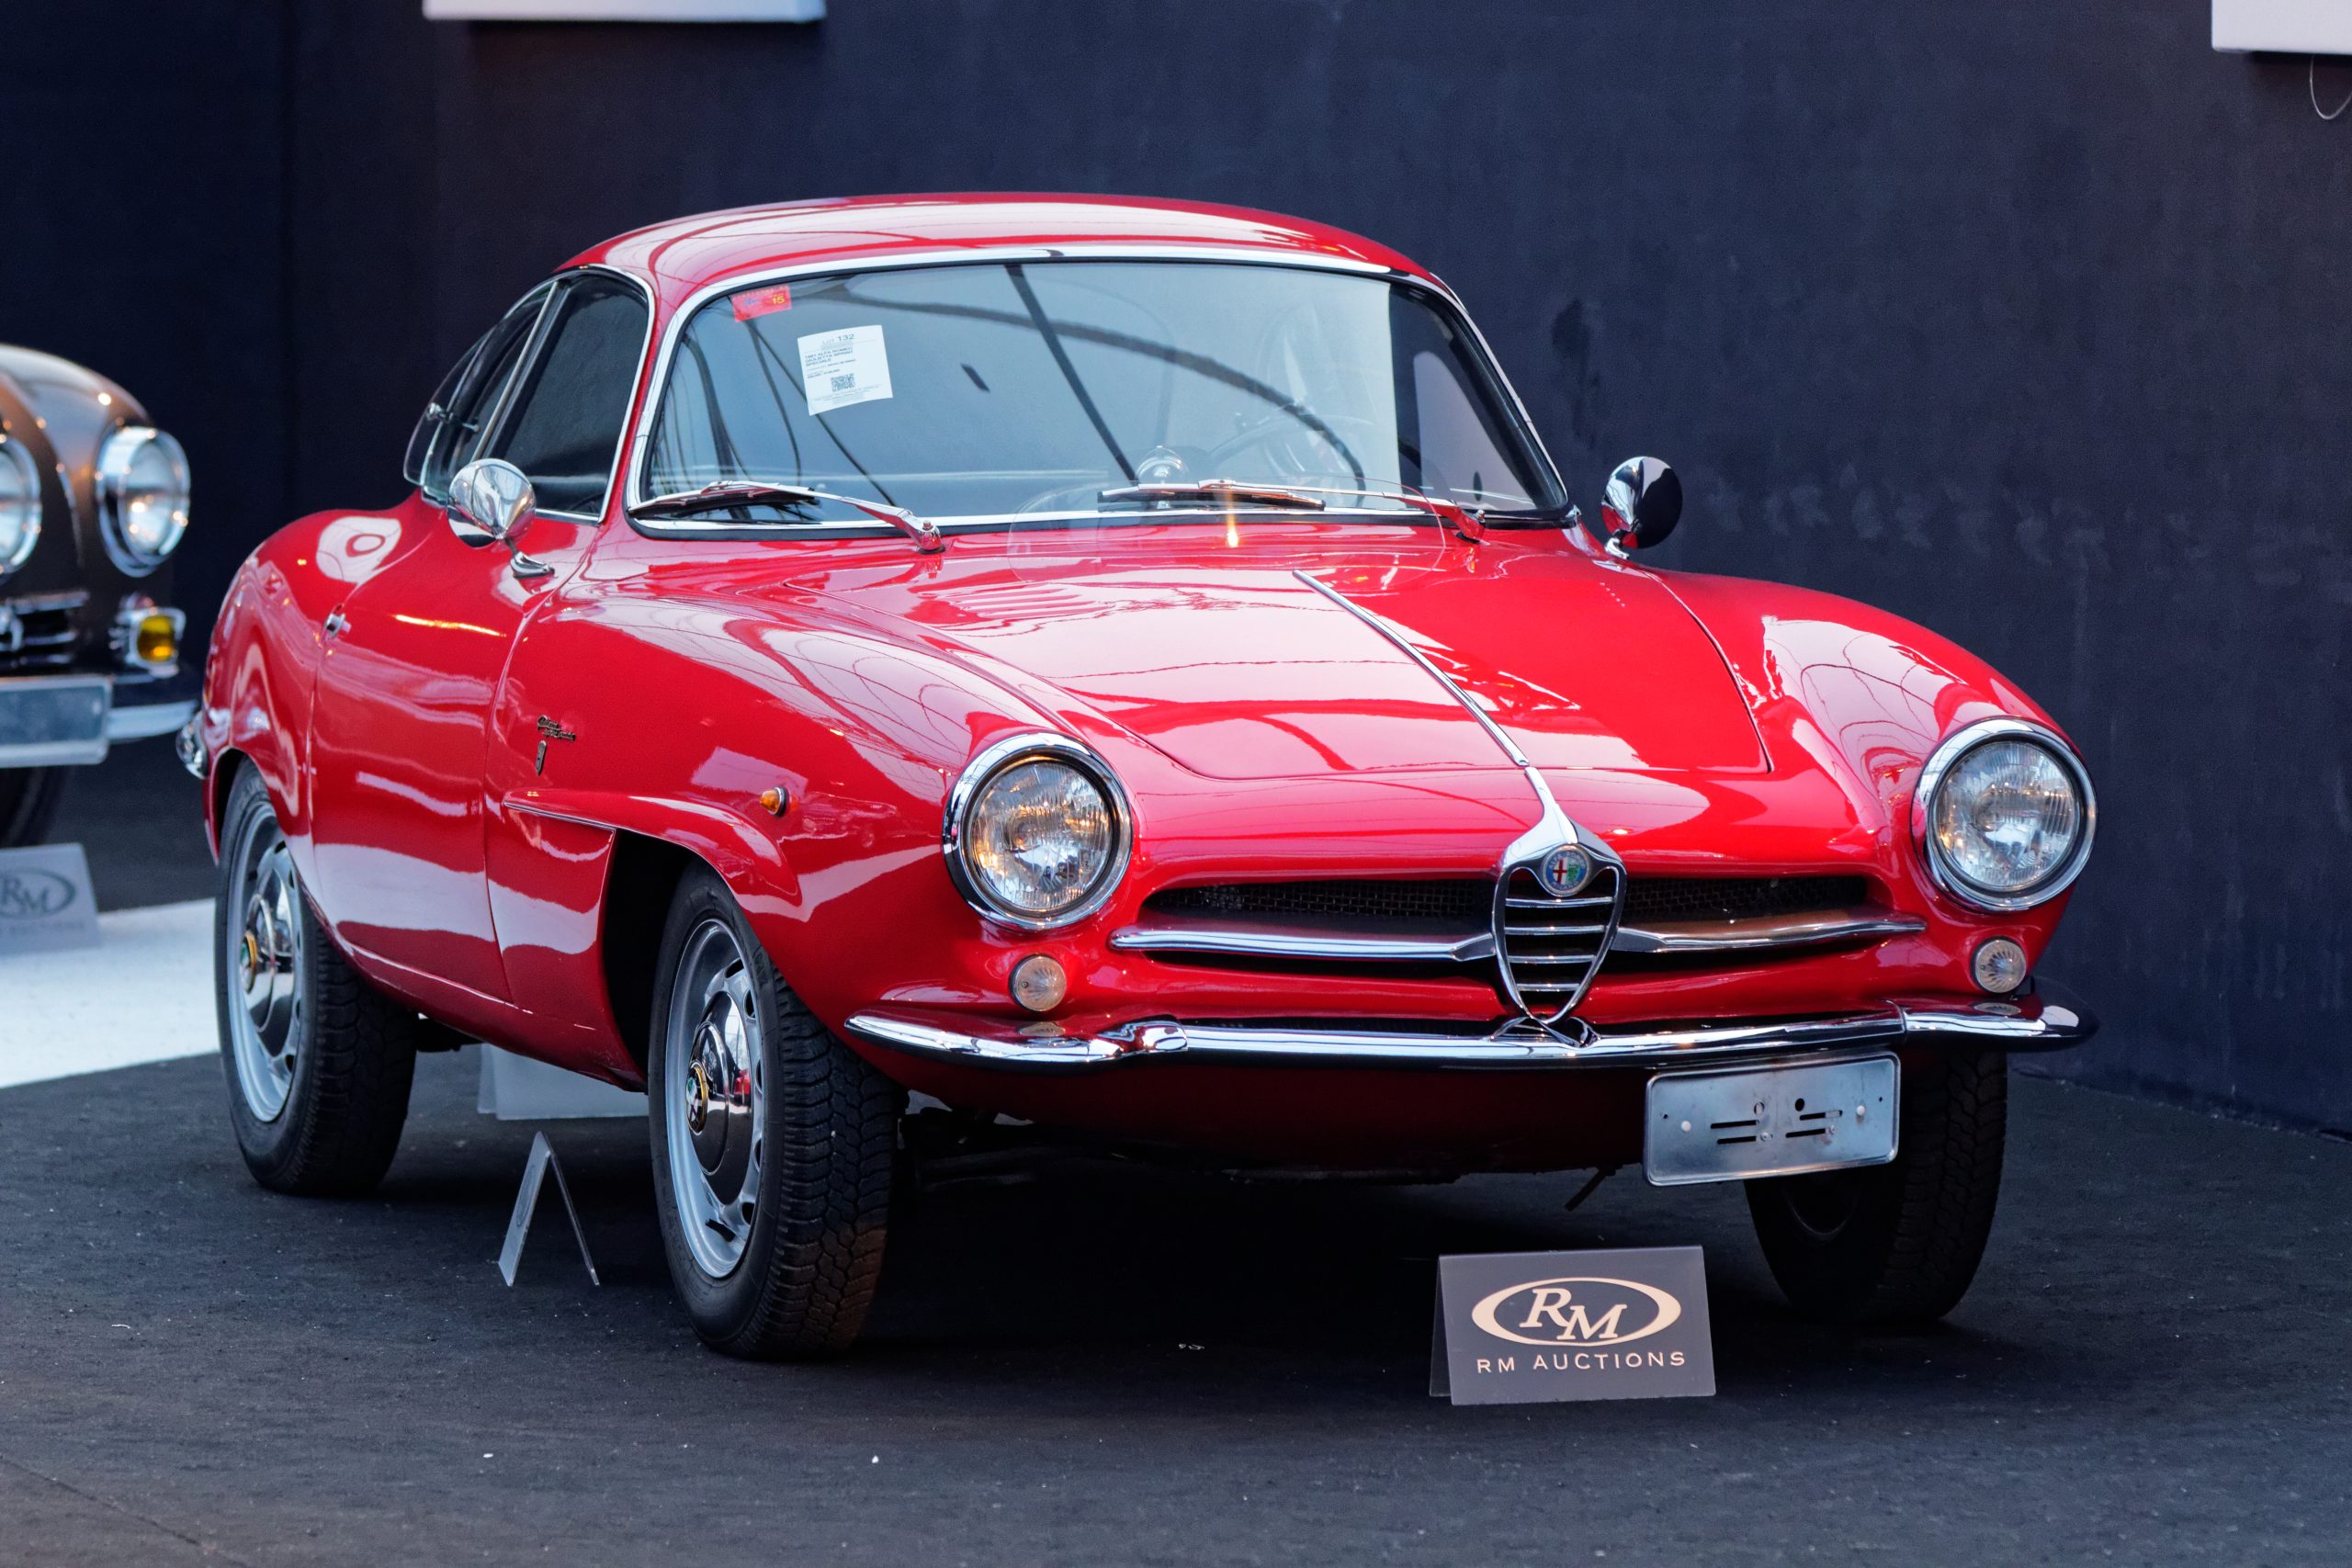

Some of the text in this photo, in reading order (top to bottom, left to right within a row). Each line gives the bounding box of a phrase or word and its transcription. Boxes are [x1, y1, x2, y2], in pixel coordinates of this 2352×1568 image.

[838, 333, 854, 342] 132
[1519, 1288, 1627, 1340] RM
[1476, 1351, 1686, 1373] RM AUCTIONS
